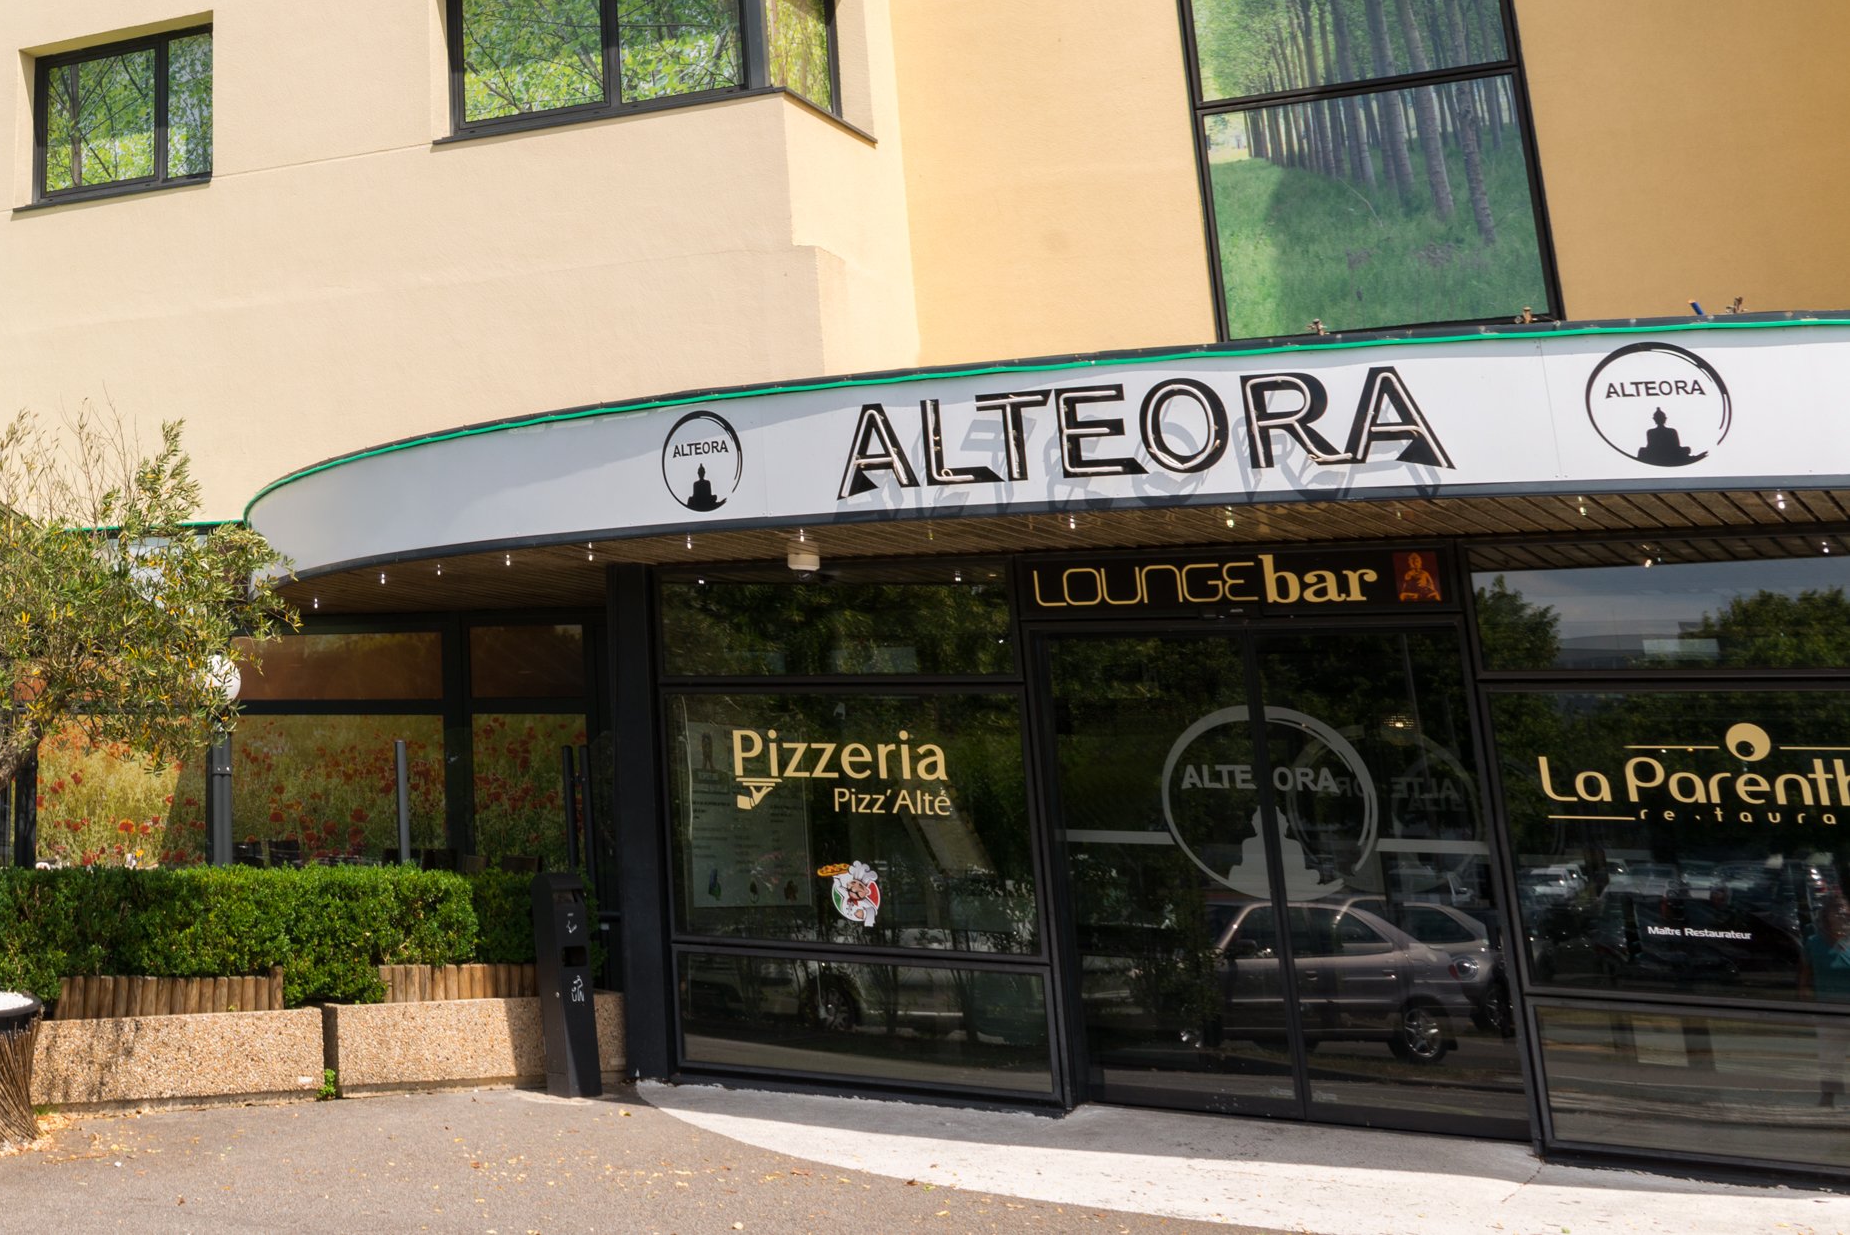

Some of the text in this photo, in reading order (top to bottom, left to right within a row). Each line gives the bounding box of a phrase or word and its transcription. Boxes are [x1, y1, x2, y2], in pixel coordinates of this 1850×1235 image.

[1605, 379, 1706, 399] ALTEORA
[672, 439, 730, 459] ALTEORA
[837, 366, 1456, 501] ALTEORA
[1032, 554, 1378, 607] LOUNGE bar
[732, 729, 949, 782] Pizzeria
[1538, 756, 1612, 803] La
[1639, 806, 1838, 826] retaura
[1683, 927, 1752, 941] Restaurateur
